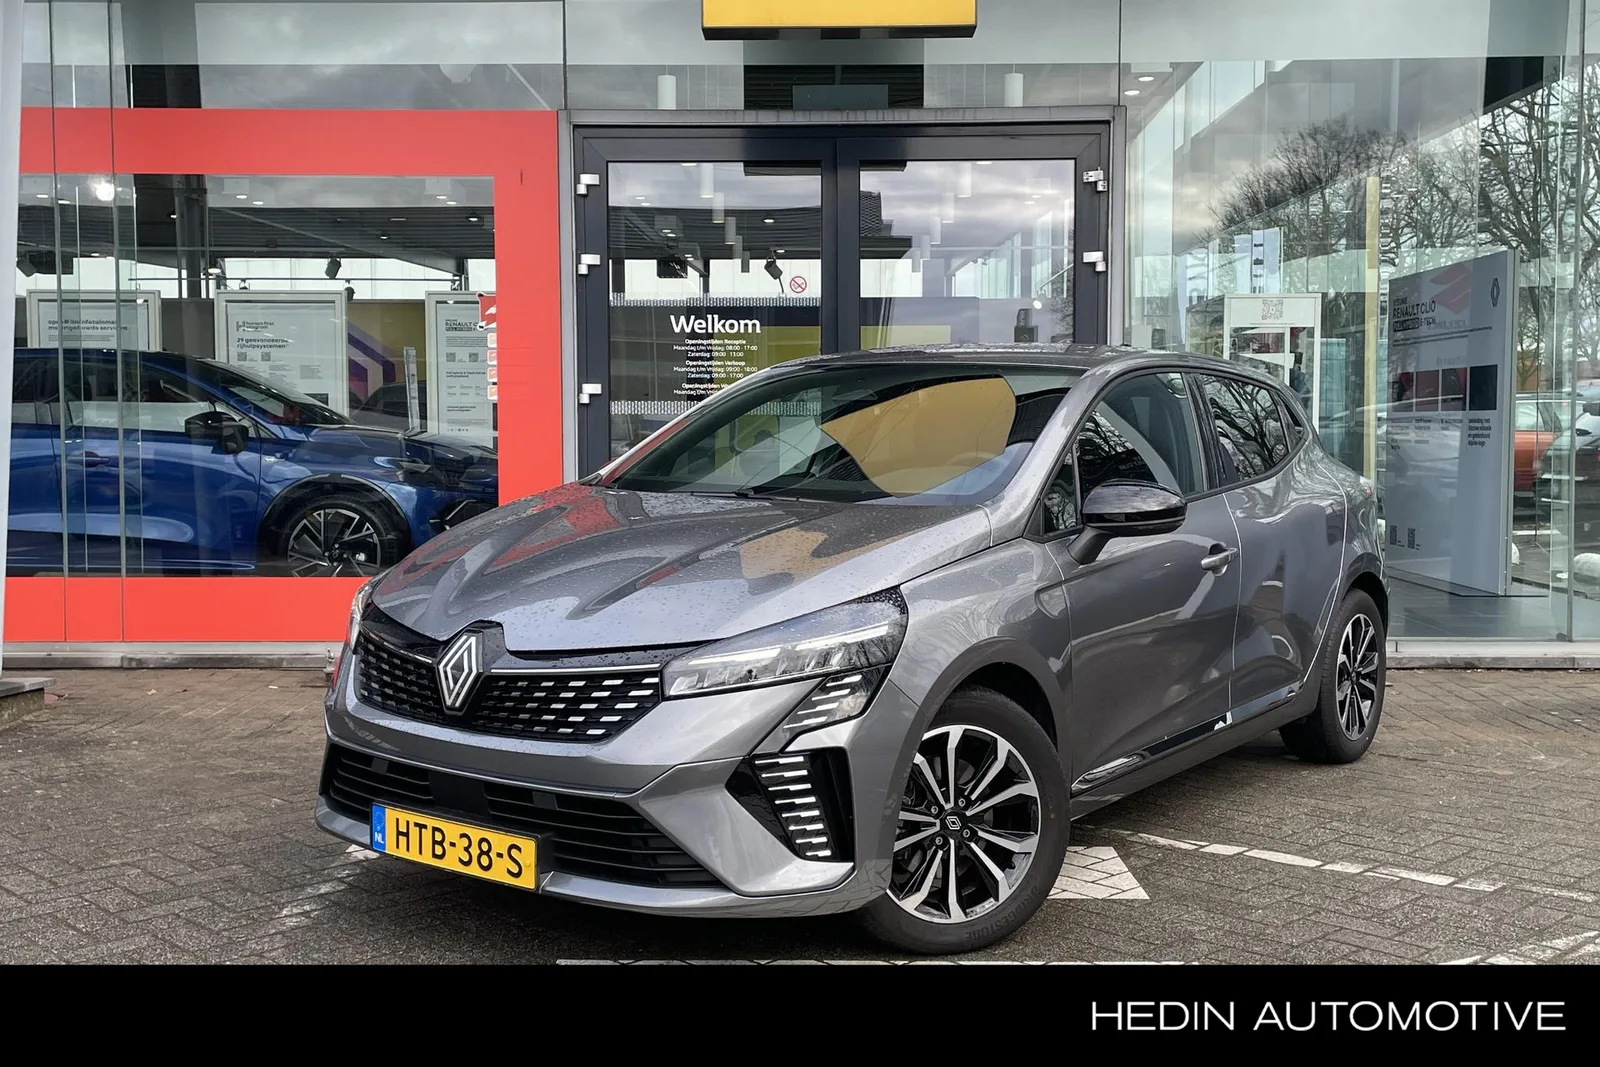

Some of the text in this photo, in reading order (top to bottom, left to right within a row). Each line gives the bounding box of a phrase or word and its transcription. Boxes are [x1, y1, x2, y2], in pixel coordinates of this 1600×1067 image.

[1393, 300, 1436, 319] RENAULT CLIO
[669, 314, 762, 334] Welkom
[374, 832, 385, 844] NL
[395, 817, 523, 879] HTB-38-S
